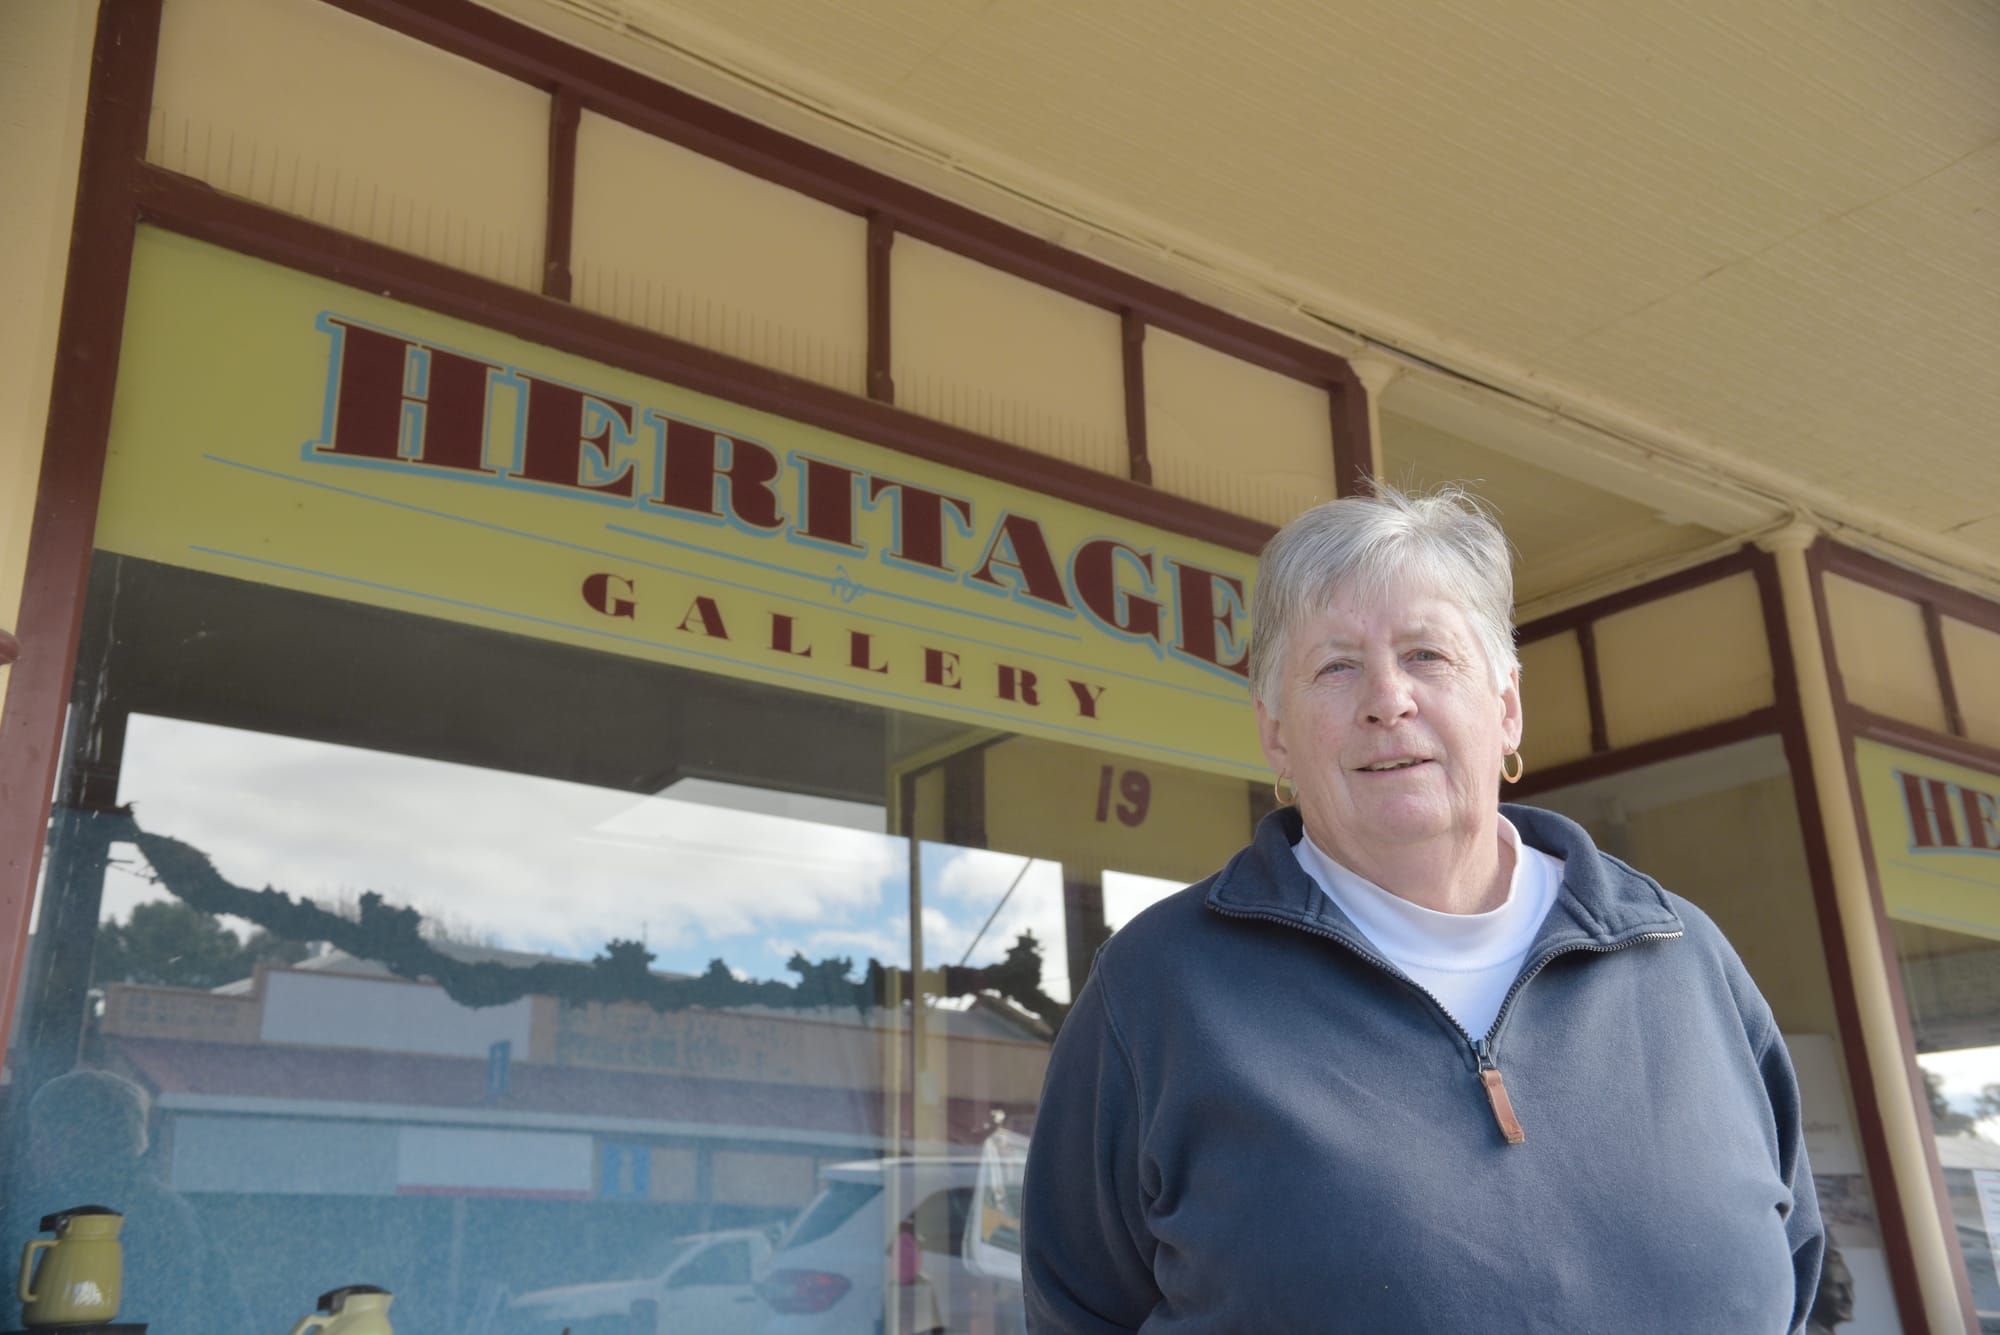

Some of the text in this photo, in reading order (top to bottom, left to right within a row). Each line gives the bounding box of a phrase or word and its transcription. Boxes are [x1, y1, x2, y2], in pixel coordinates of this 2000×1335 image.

[302, 311, 1249, 687] HERITAGE
[582, 572, 1106, 719] GALLERY
[1096, 764, 1152, 828] 19
